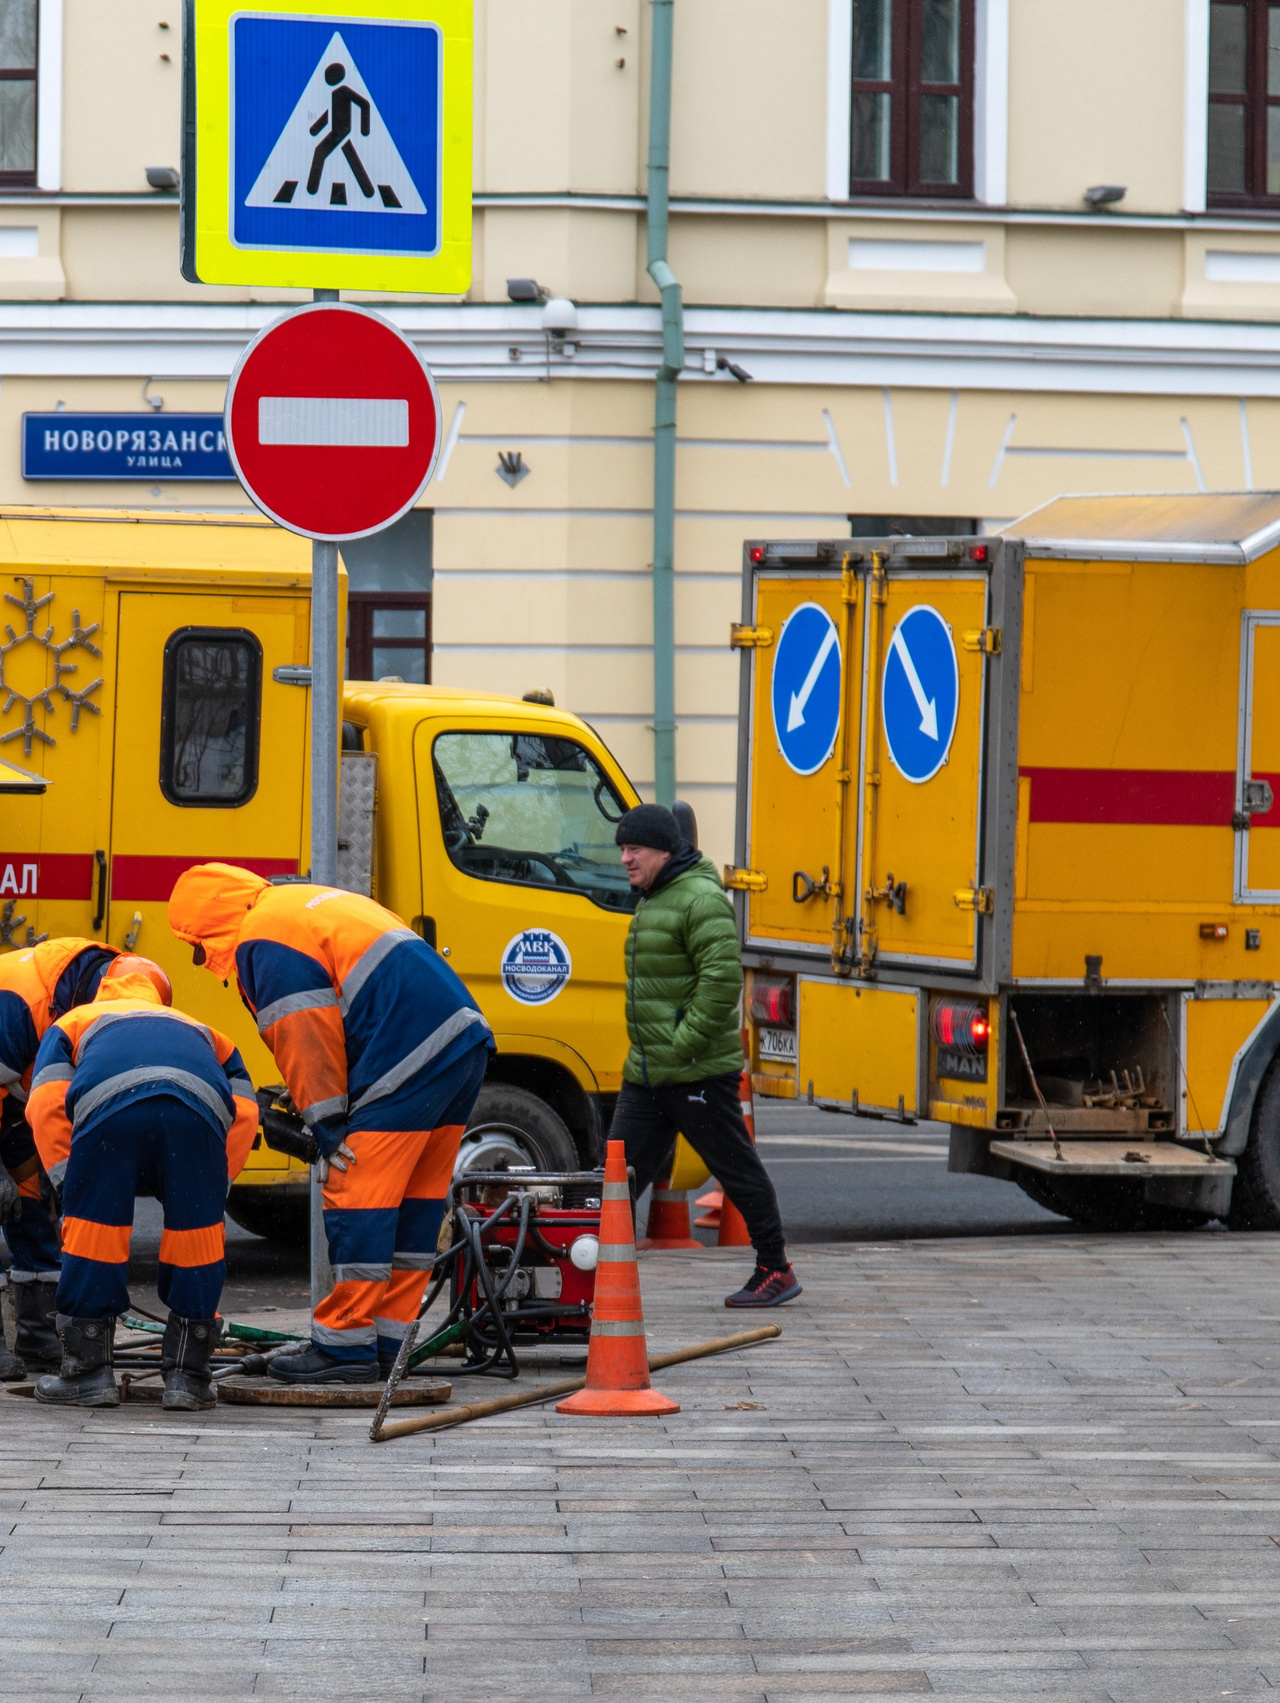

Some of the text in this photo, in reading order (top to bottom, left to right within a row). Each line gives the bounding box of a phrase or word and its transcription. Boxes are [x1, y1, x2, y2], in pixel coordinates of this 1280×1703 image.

[127, 456, 182, 467] УЛИЦА
[516, 940, 555, 953] МВК
[505, 964, 567, 973] МОСВОДОКАНАЛ
[945, 1054, 985, 1075] MAN
